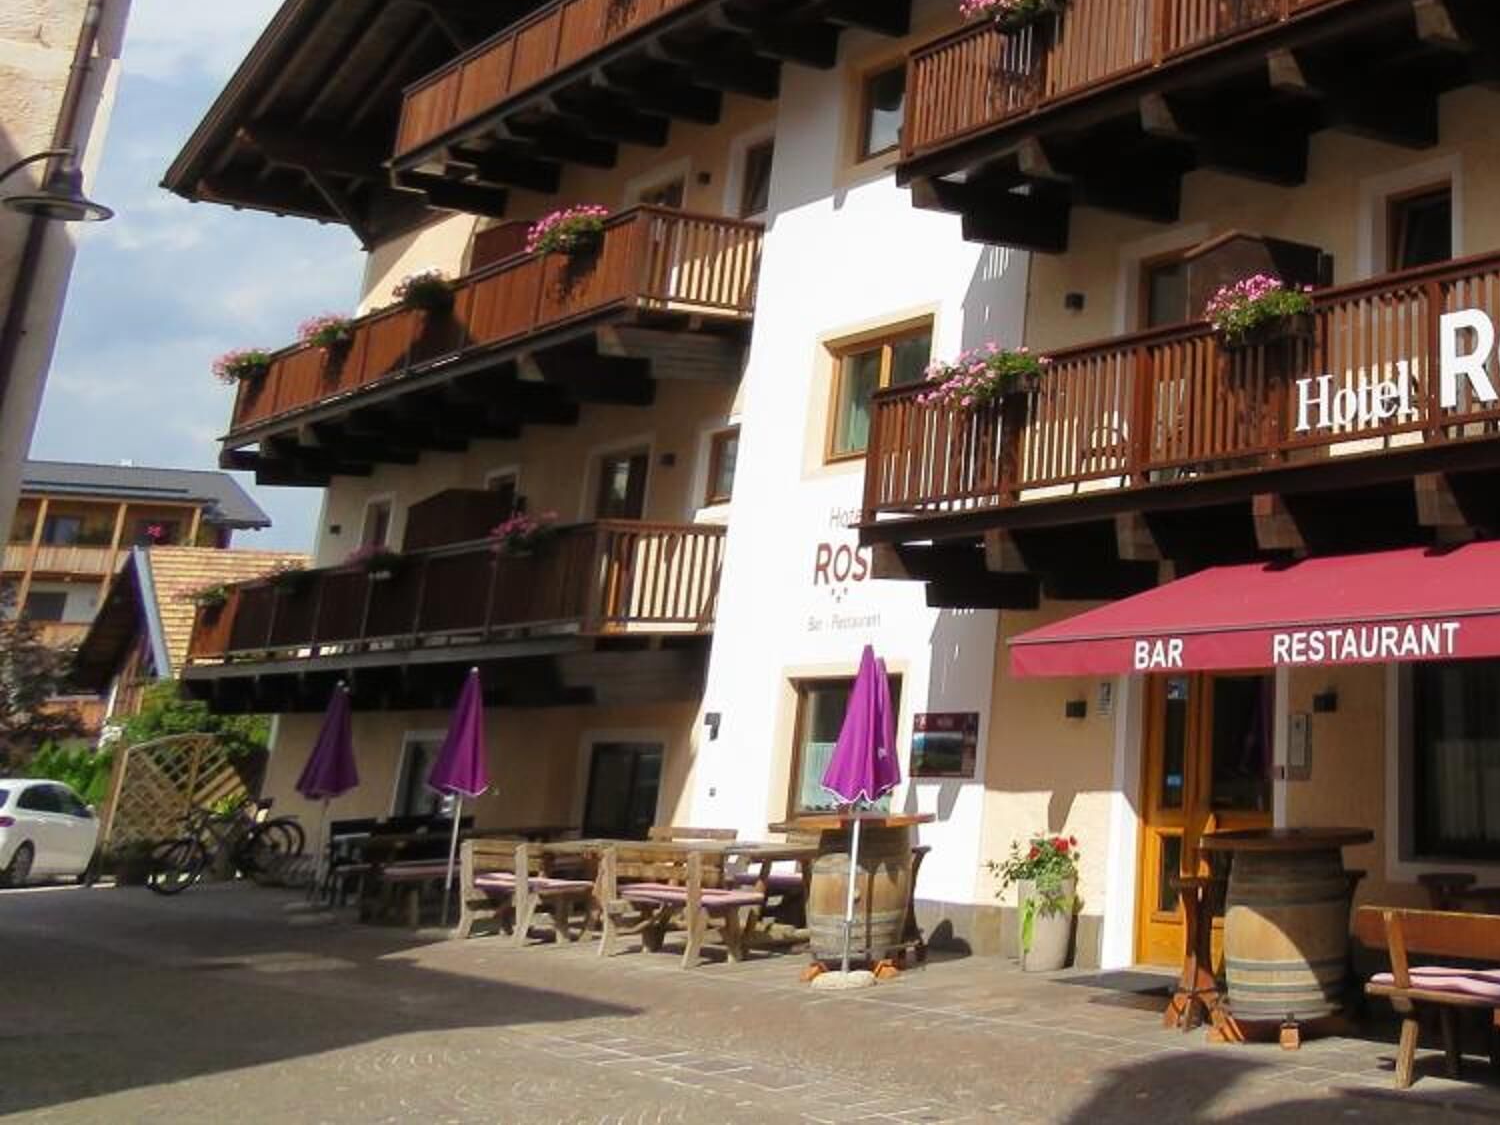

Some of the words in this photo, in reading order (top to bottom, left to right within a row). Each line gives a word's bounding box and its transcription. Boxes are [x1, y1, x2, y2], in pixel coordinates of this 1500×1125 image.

[1294, 360, 1420, 432] Hotel
[812, 541, 870, 586] ROS
[1134, 638, 1184, 670] BAR
[1272, 621, 1461, 664] RESTAURANT
